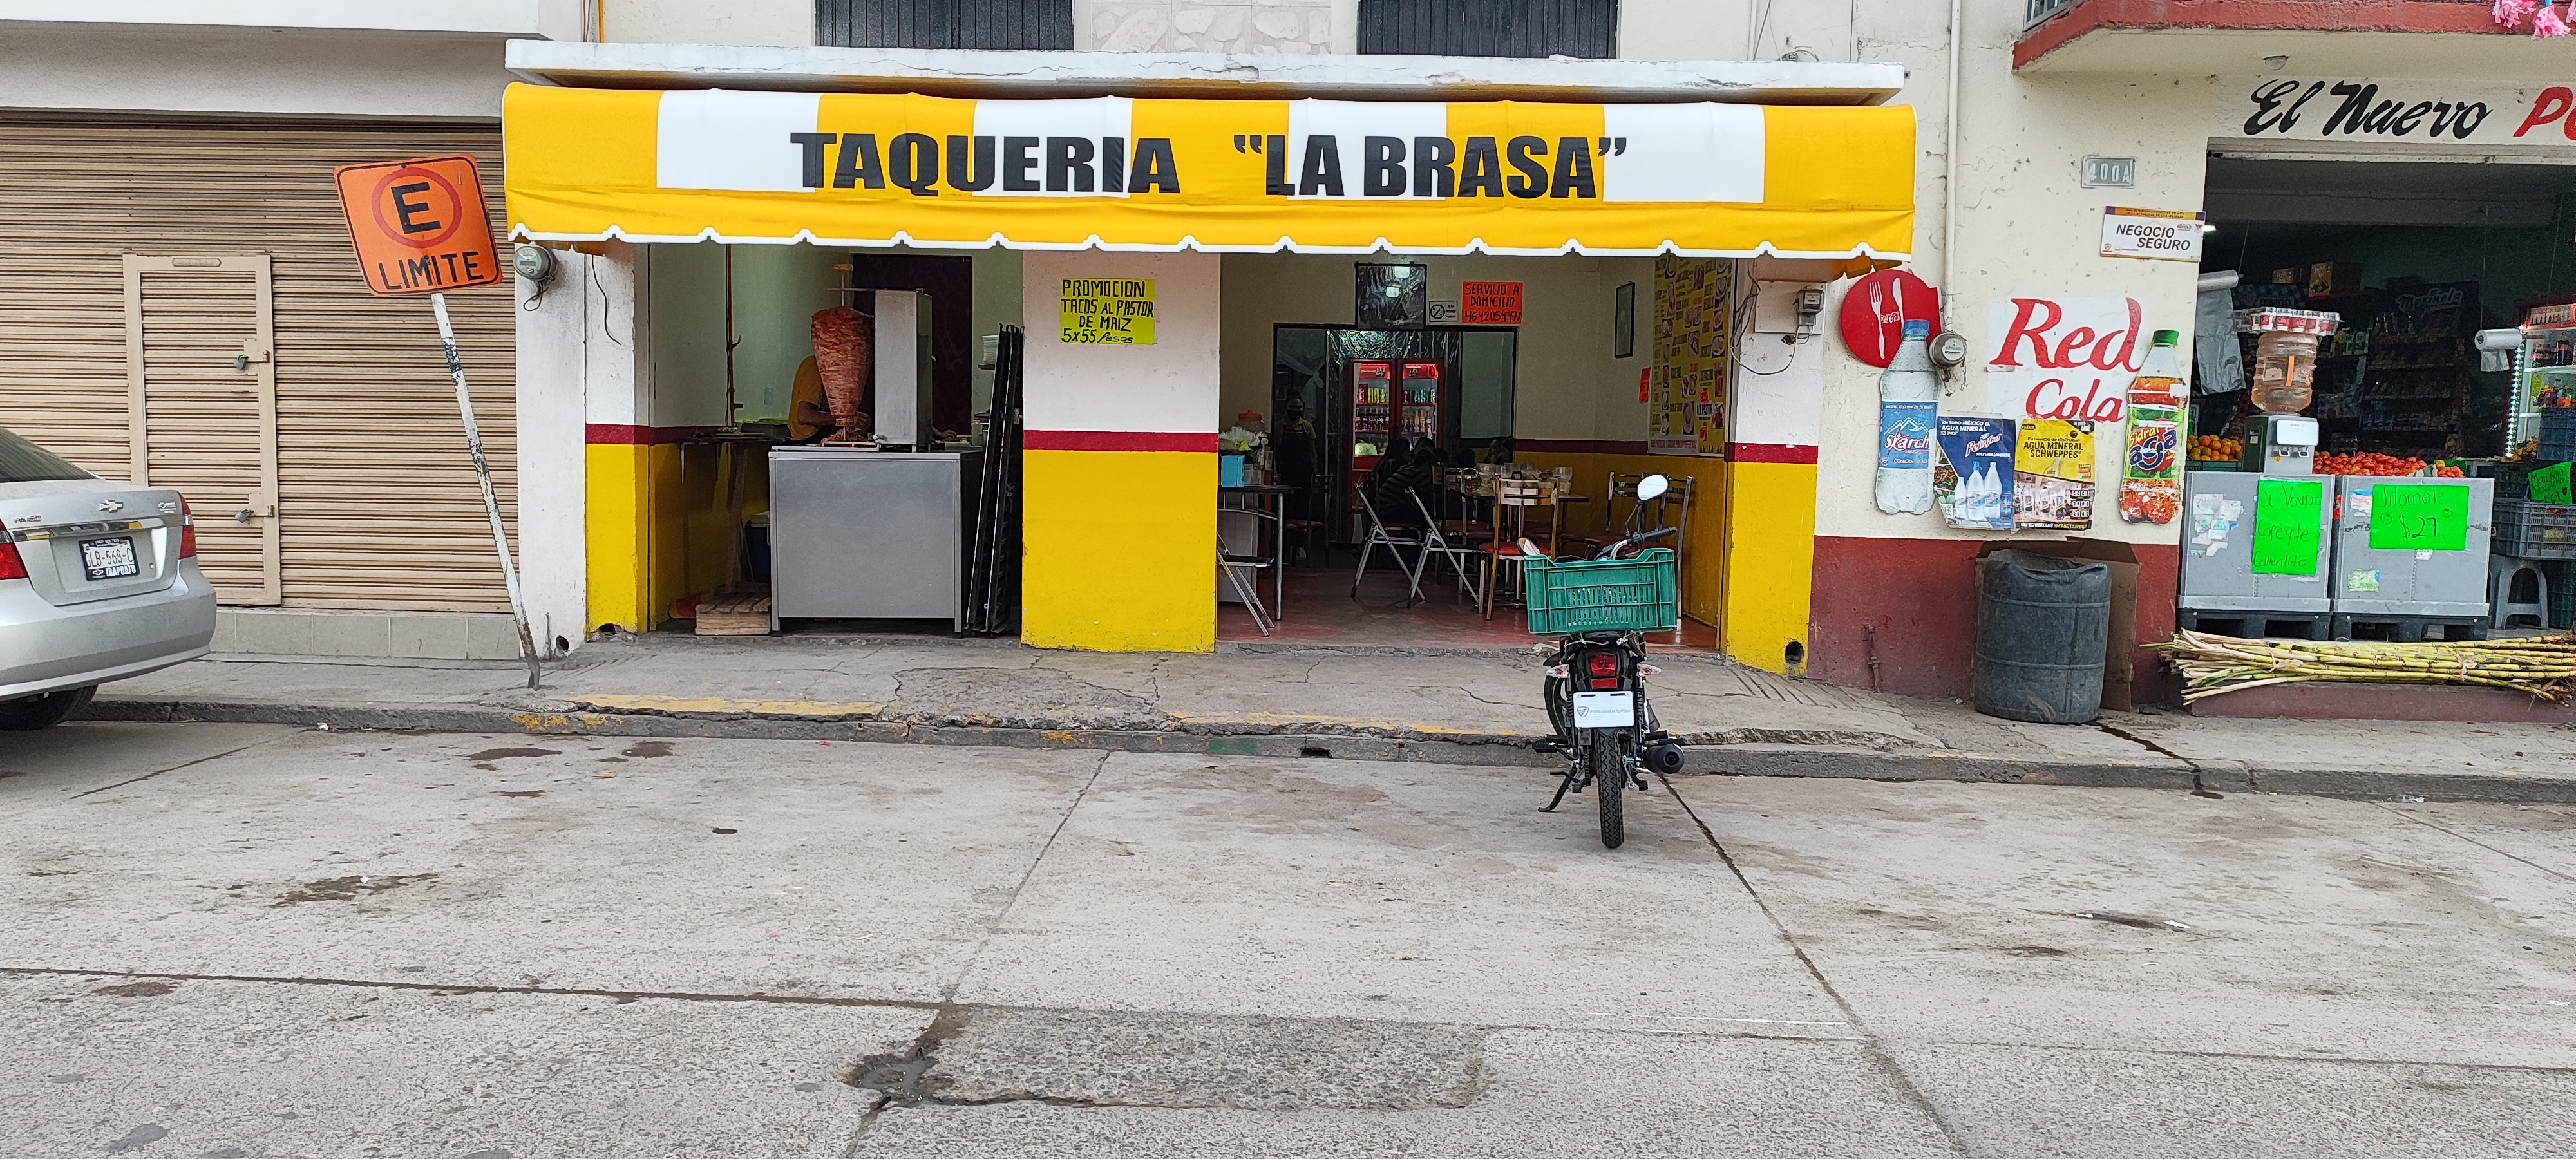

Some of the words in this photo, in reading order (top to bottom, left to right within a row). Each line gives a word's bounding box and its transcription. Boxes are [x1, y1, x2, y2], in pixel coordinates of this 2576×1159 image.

[2243, 79, 2325, 136] El
[2322, 79, 2494, 140] Nuevo
[790, 133, 1181, 197] TAQUERIA
[2087, 162, 2130, 183] 400A
[390, 182, 442, 234] E
[2116, 224, 2175, 238] NEGOCIO
[2137, 237, 2190, 251] SEGURO
[377, 251, 484, 290] LIMITE
[1062, 279, 1145, 297] PROMOCION
[1464, 283, 1507, 296] SERVICIO
[1513, 284, 1519, 296] A
[1061, 298, 1098, 314] TACOS
[1101, 302, 1113, 314] AL
[1116, 299, 1154, 318] PASTOR
[1470, 296, 1515, 308] DOMICILIO
[1079, 316, 1093, 328] DE
[1100, 316, 1133, 332] MAIZ
[1061, 328, 1097, 343] 5x55
[1989, 297, 2142, 373] Red
[2025, 378, 2125, 423] Cola
[2023, 442, 2045, 450] AGUA
[2047, 442, 2084, 451] MINERAL
[85, 547, 133, 568] GLB-568-C
[105, 565, 137, 577] IRAPUATO
